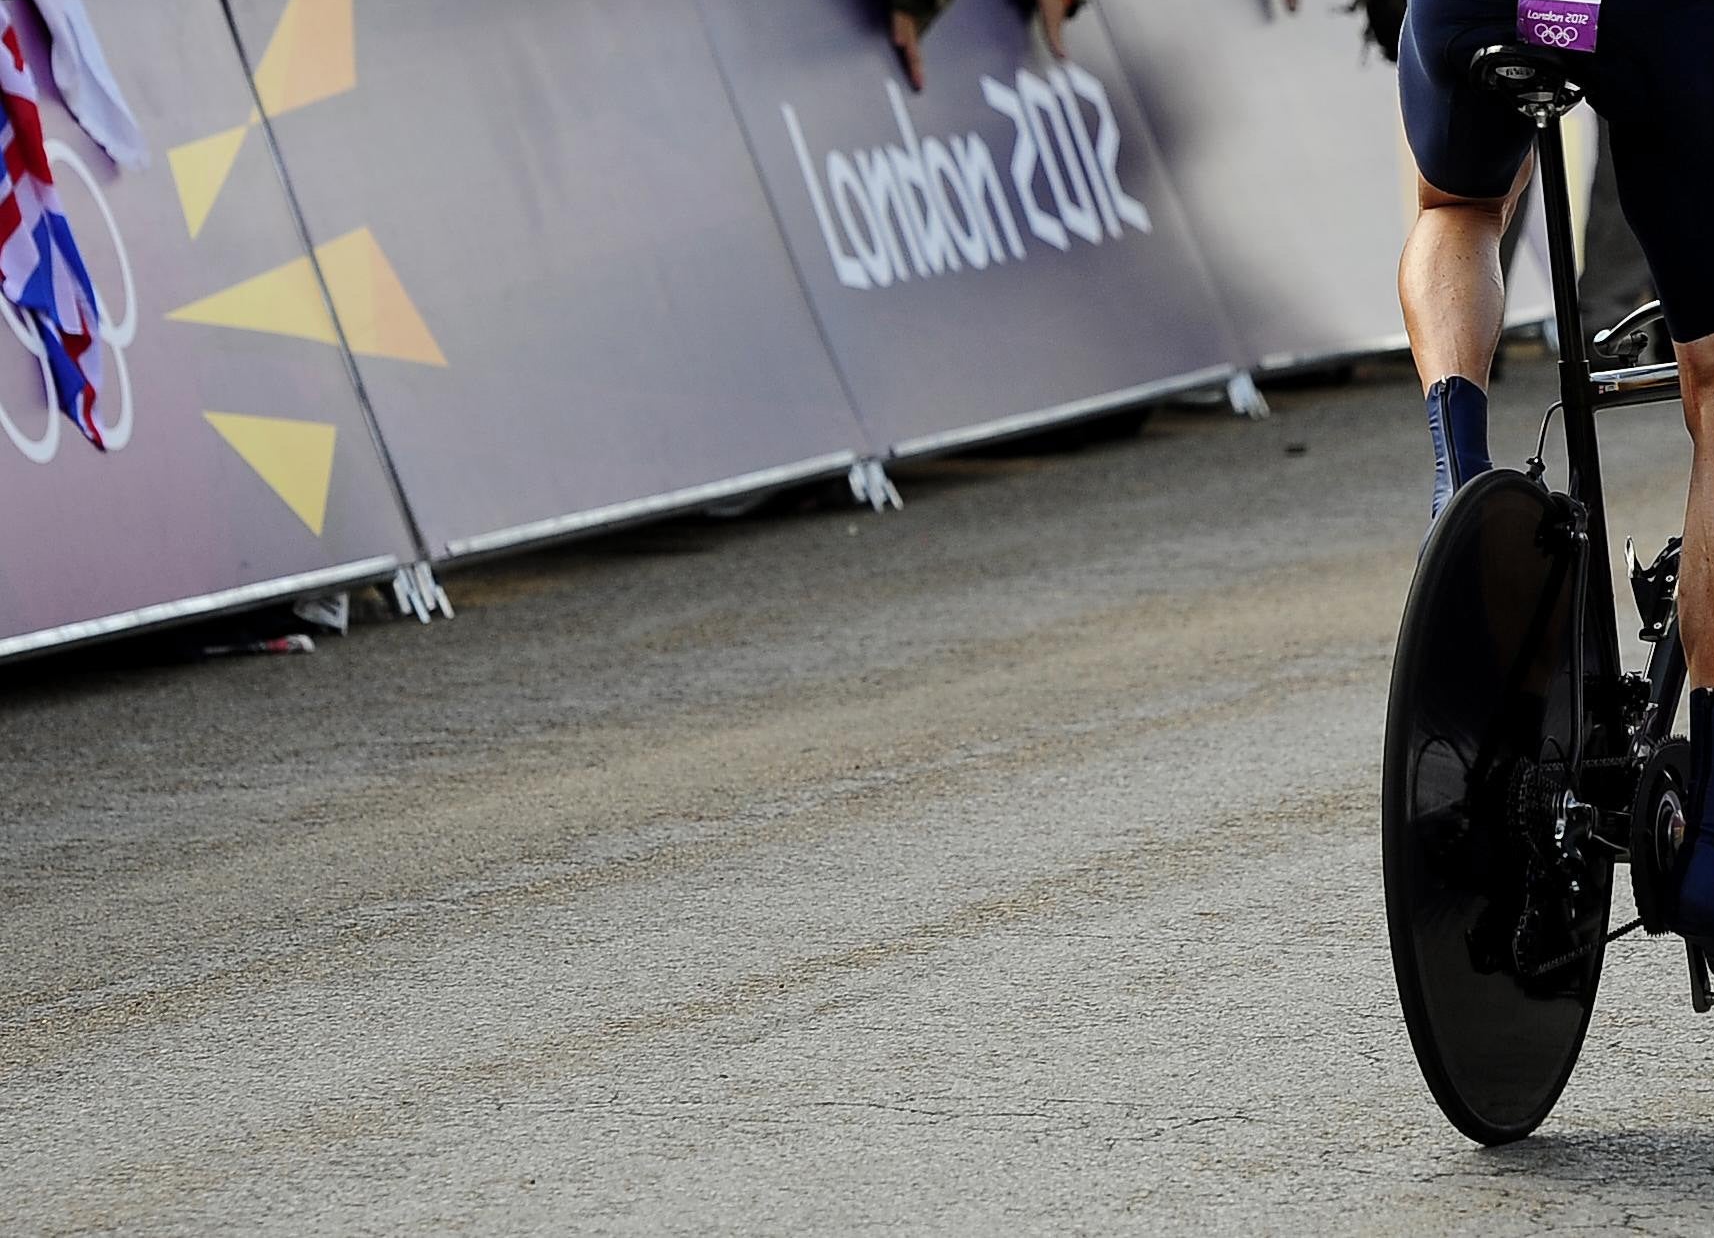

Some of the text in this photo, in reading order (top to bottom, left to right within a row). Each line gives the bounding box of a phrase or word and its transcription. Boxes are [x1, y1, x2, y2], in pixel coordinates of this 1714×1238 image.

[1527, 9, 1589, 25] London 2012
[780, 61, 1153, 291] London 2012
